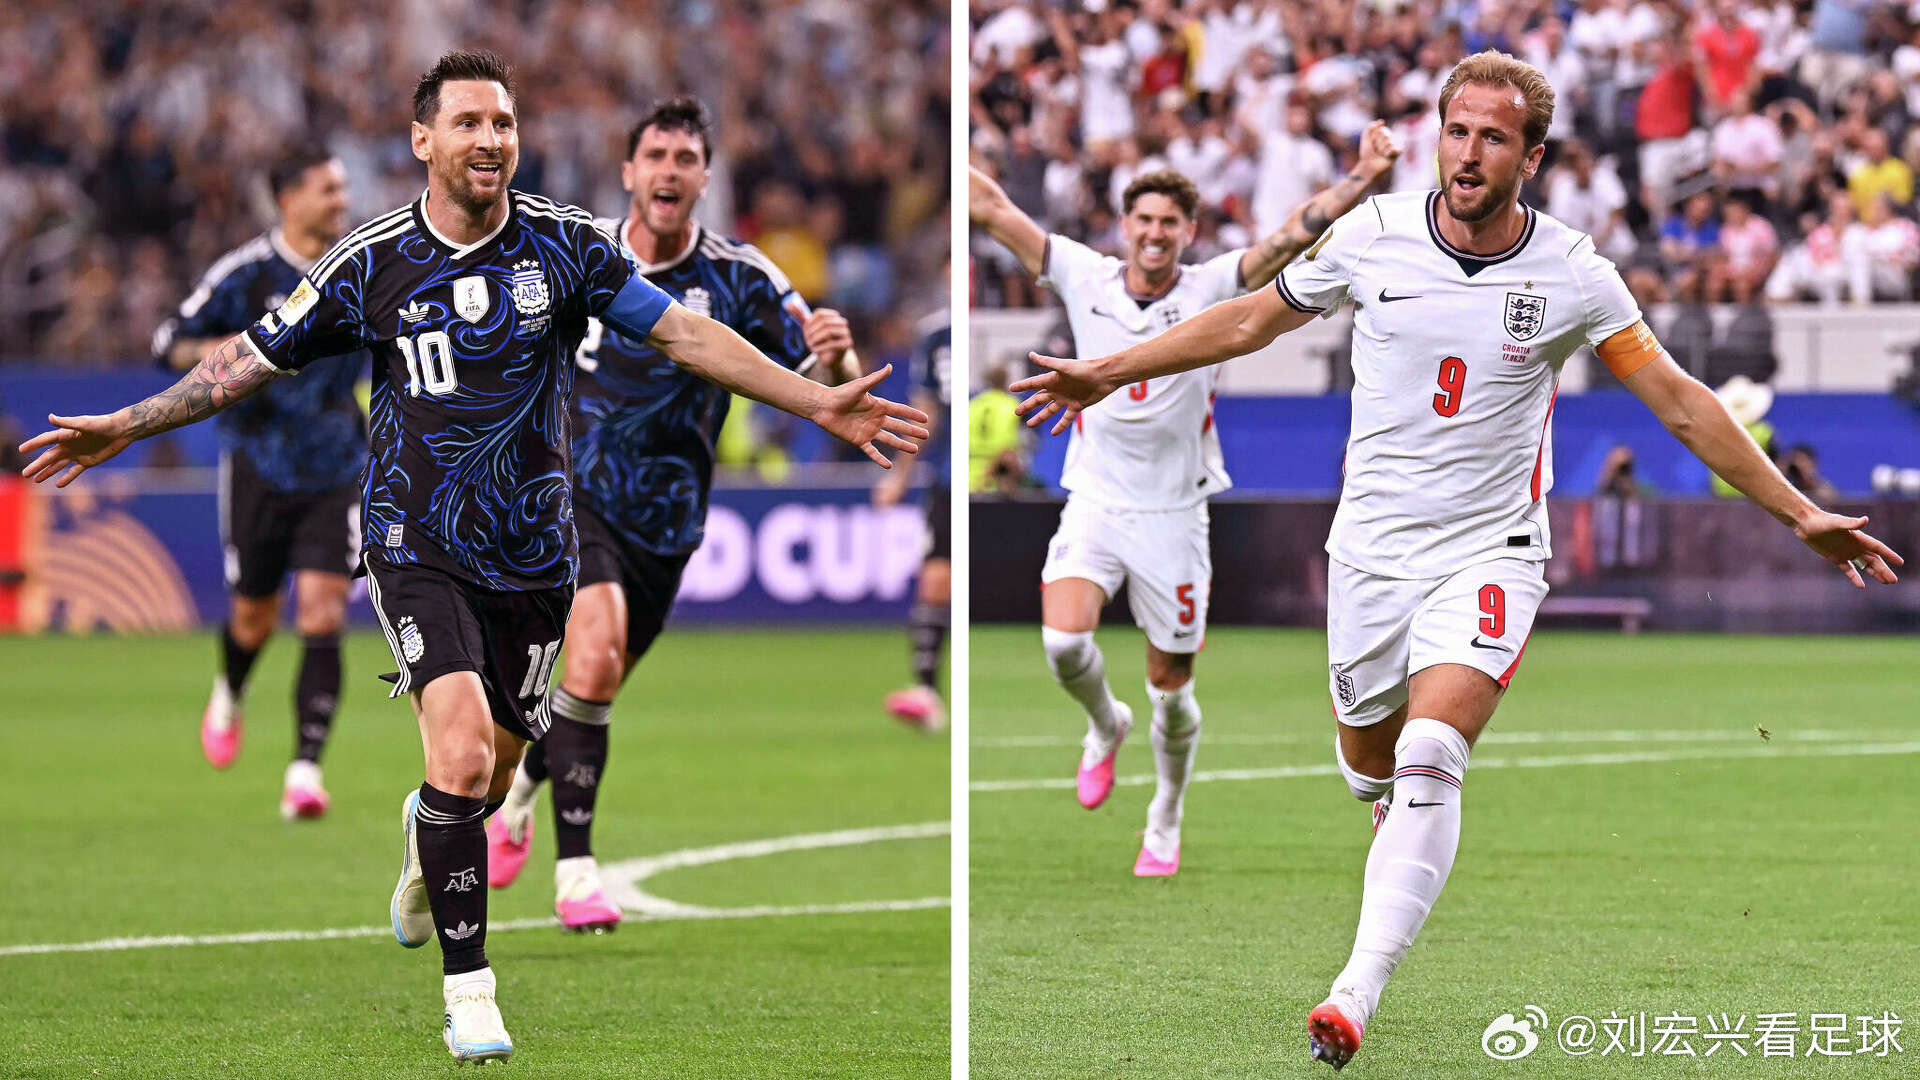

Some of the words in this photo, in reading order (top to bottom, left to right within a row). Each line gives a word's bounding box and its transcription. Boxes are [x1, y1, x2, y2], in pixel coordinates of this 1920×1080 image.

[521, 282, 541, 301] AFA
[396, 331, 458, 398] 10
[1502, 343, 1530, 355] CROATIA
[1432, 356, 1467, 418] 9
[757, 503, 931, 602] CUP
[1176, 584, 1195, 625] 5
[1478, 584, 1506, 638] 9
[444, 867, 479, 892] AFA
